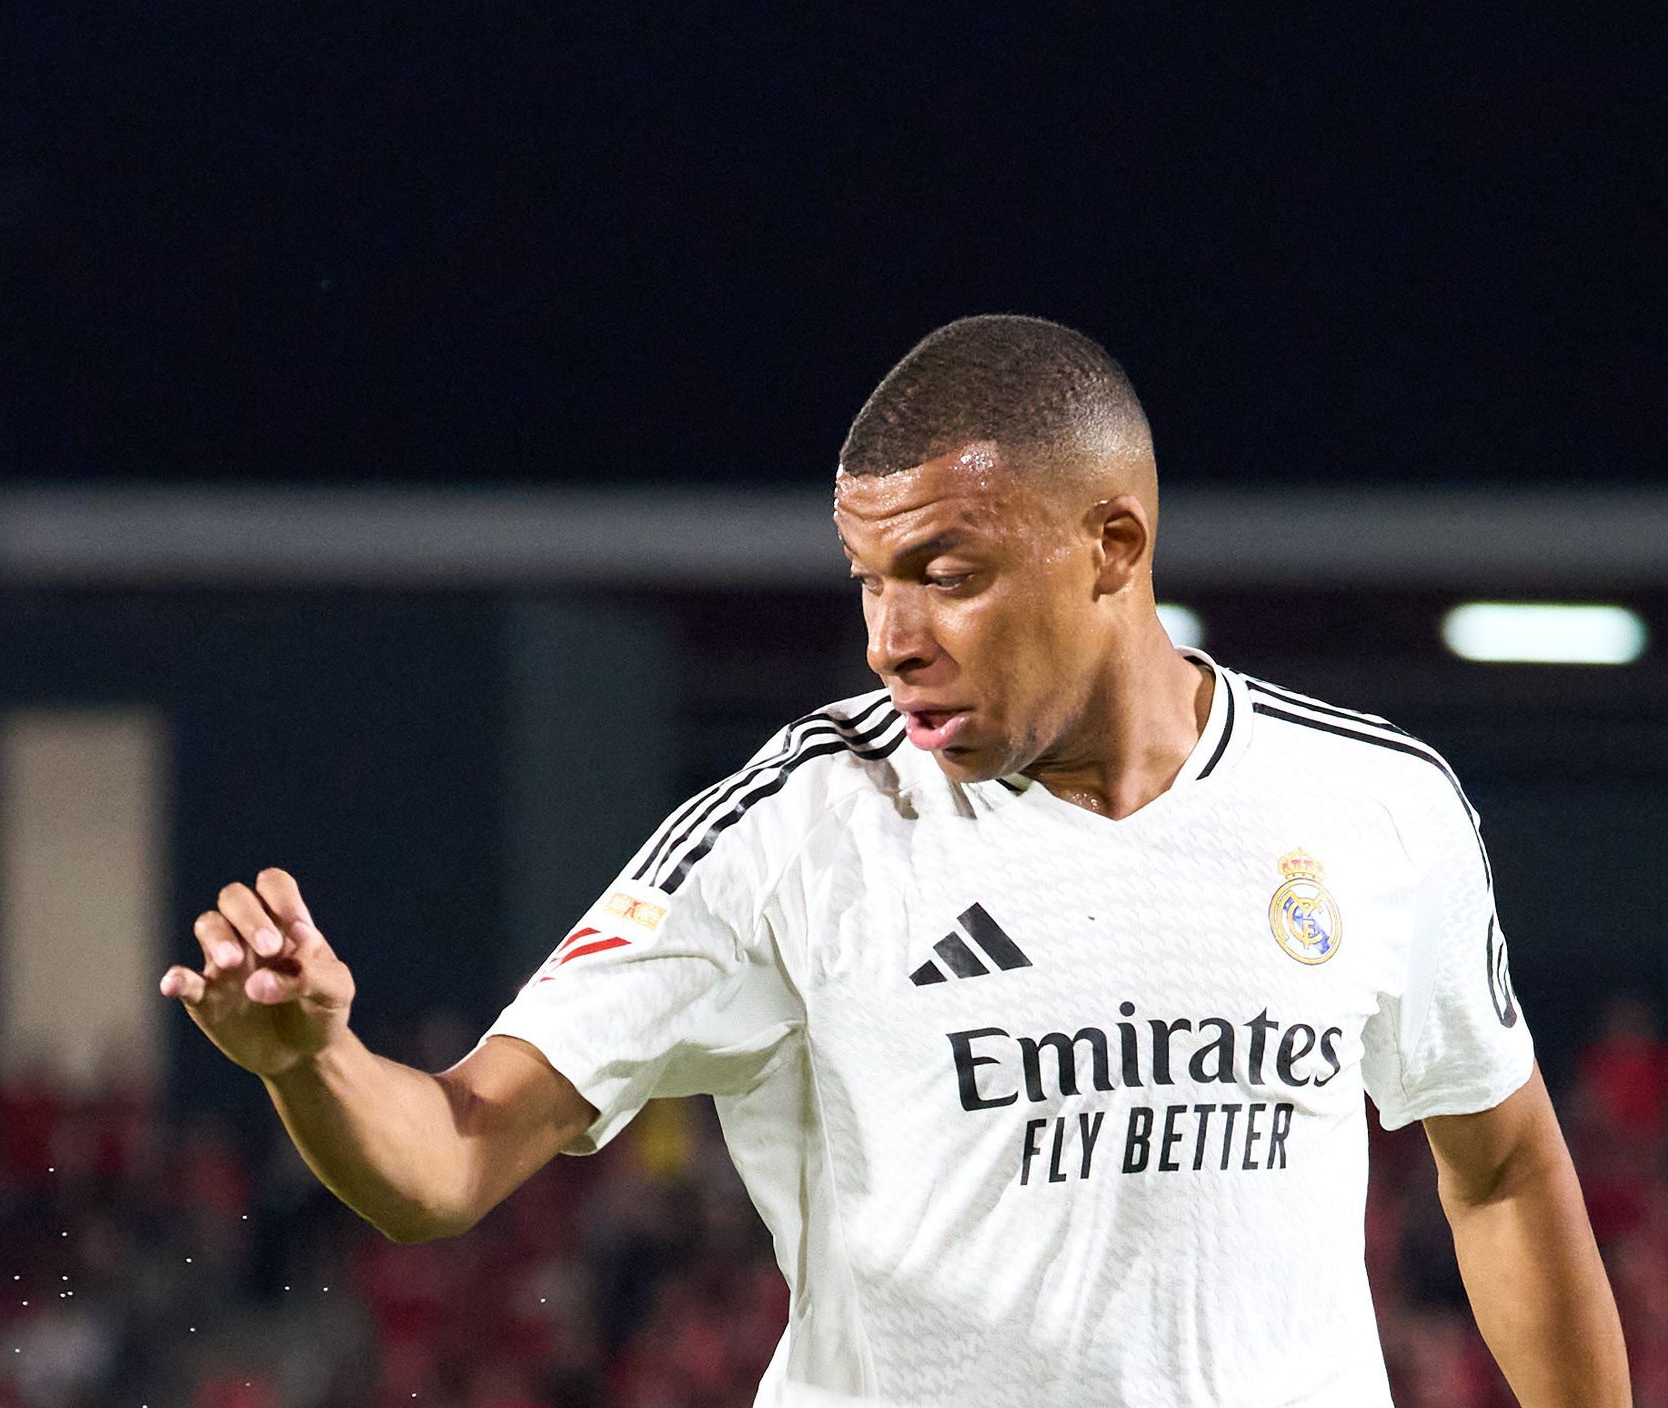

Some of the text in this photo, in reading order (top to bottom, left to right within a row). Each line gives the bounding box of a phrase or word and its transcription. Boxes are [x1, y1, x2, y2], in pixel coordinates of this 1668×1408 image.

[945, 1001, 1343, 1112] Emirates
[1020, 1103, 1294, 1186] FLY BETTER
